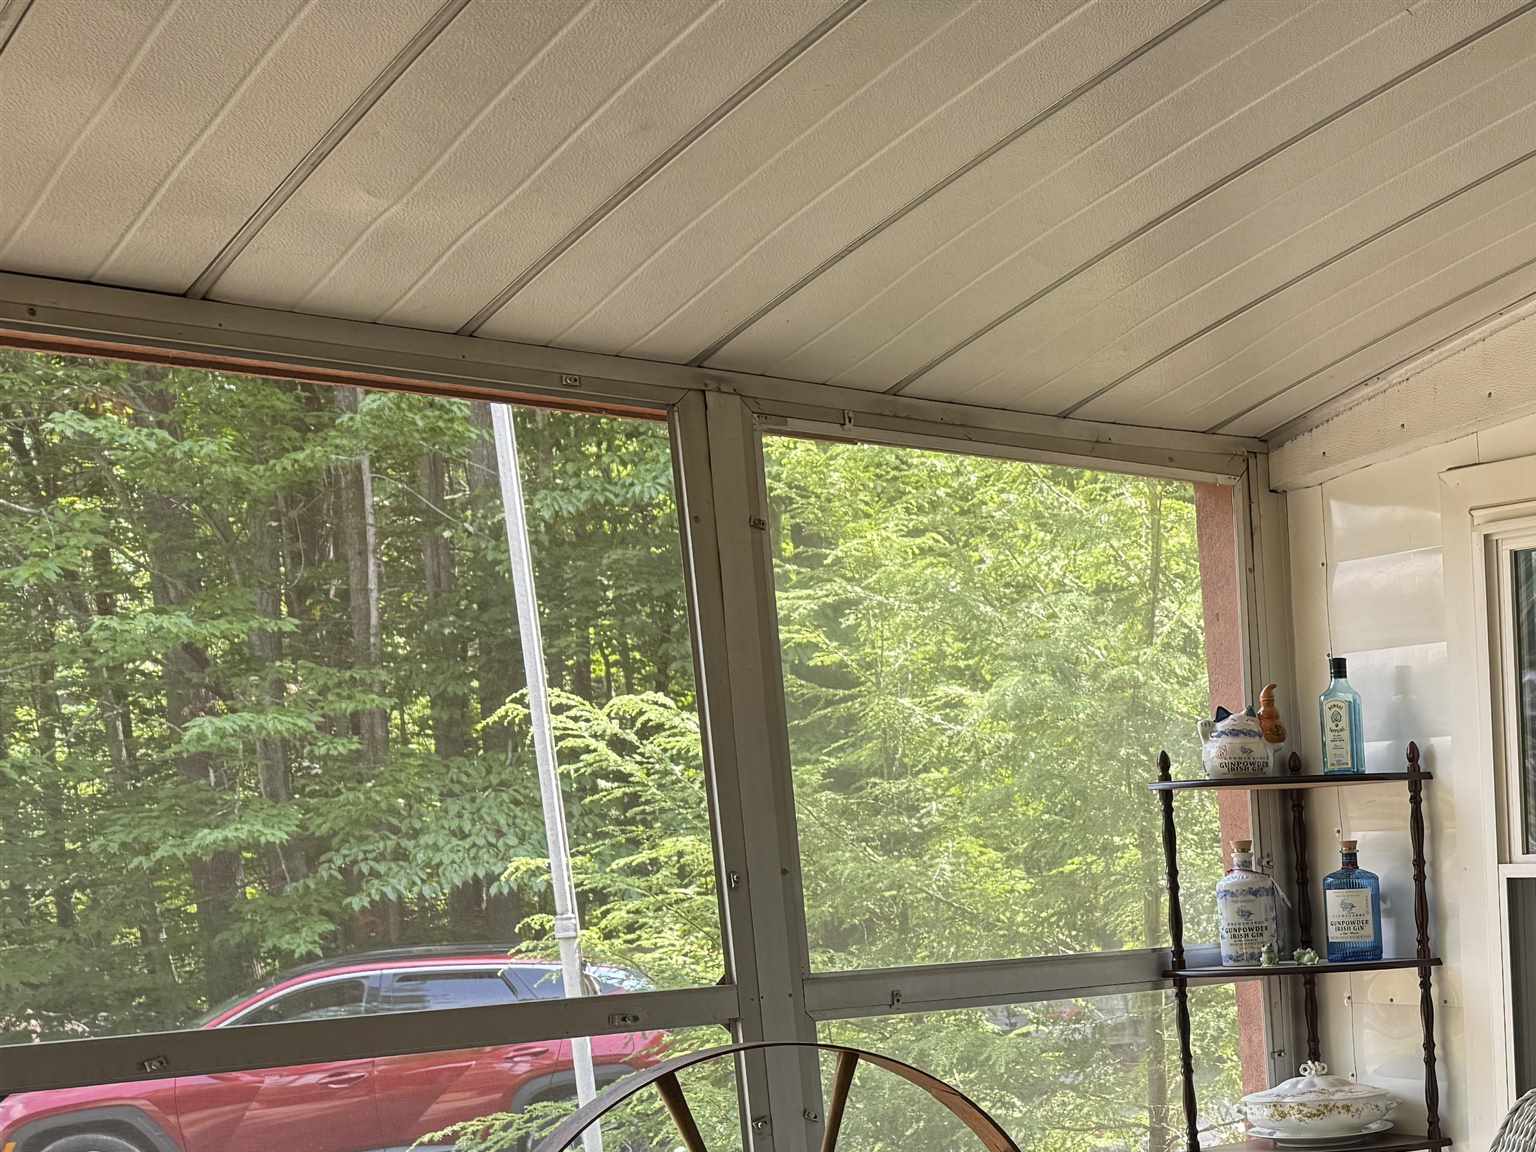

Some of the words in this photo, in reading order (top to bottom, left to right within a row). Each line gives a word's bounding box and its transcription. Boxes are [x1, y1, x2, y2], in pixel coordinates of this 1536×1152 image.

[1219, 760, 1269, 769] GUNPOWDER
[1331, 919, 1369, 927] GUNPOWDER
[1225, 925, 1268, 934] GUNPOWDER
[1230, 932, 1250, 940] IRISH
